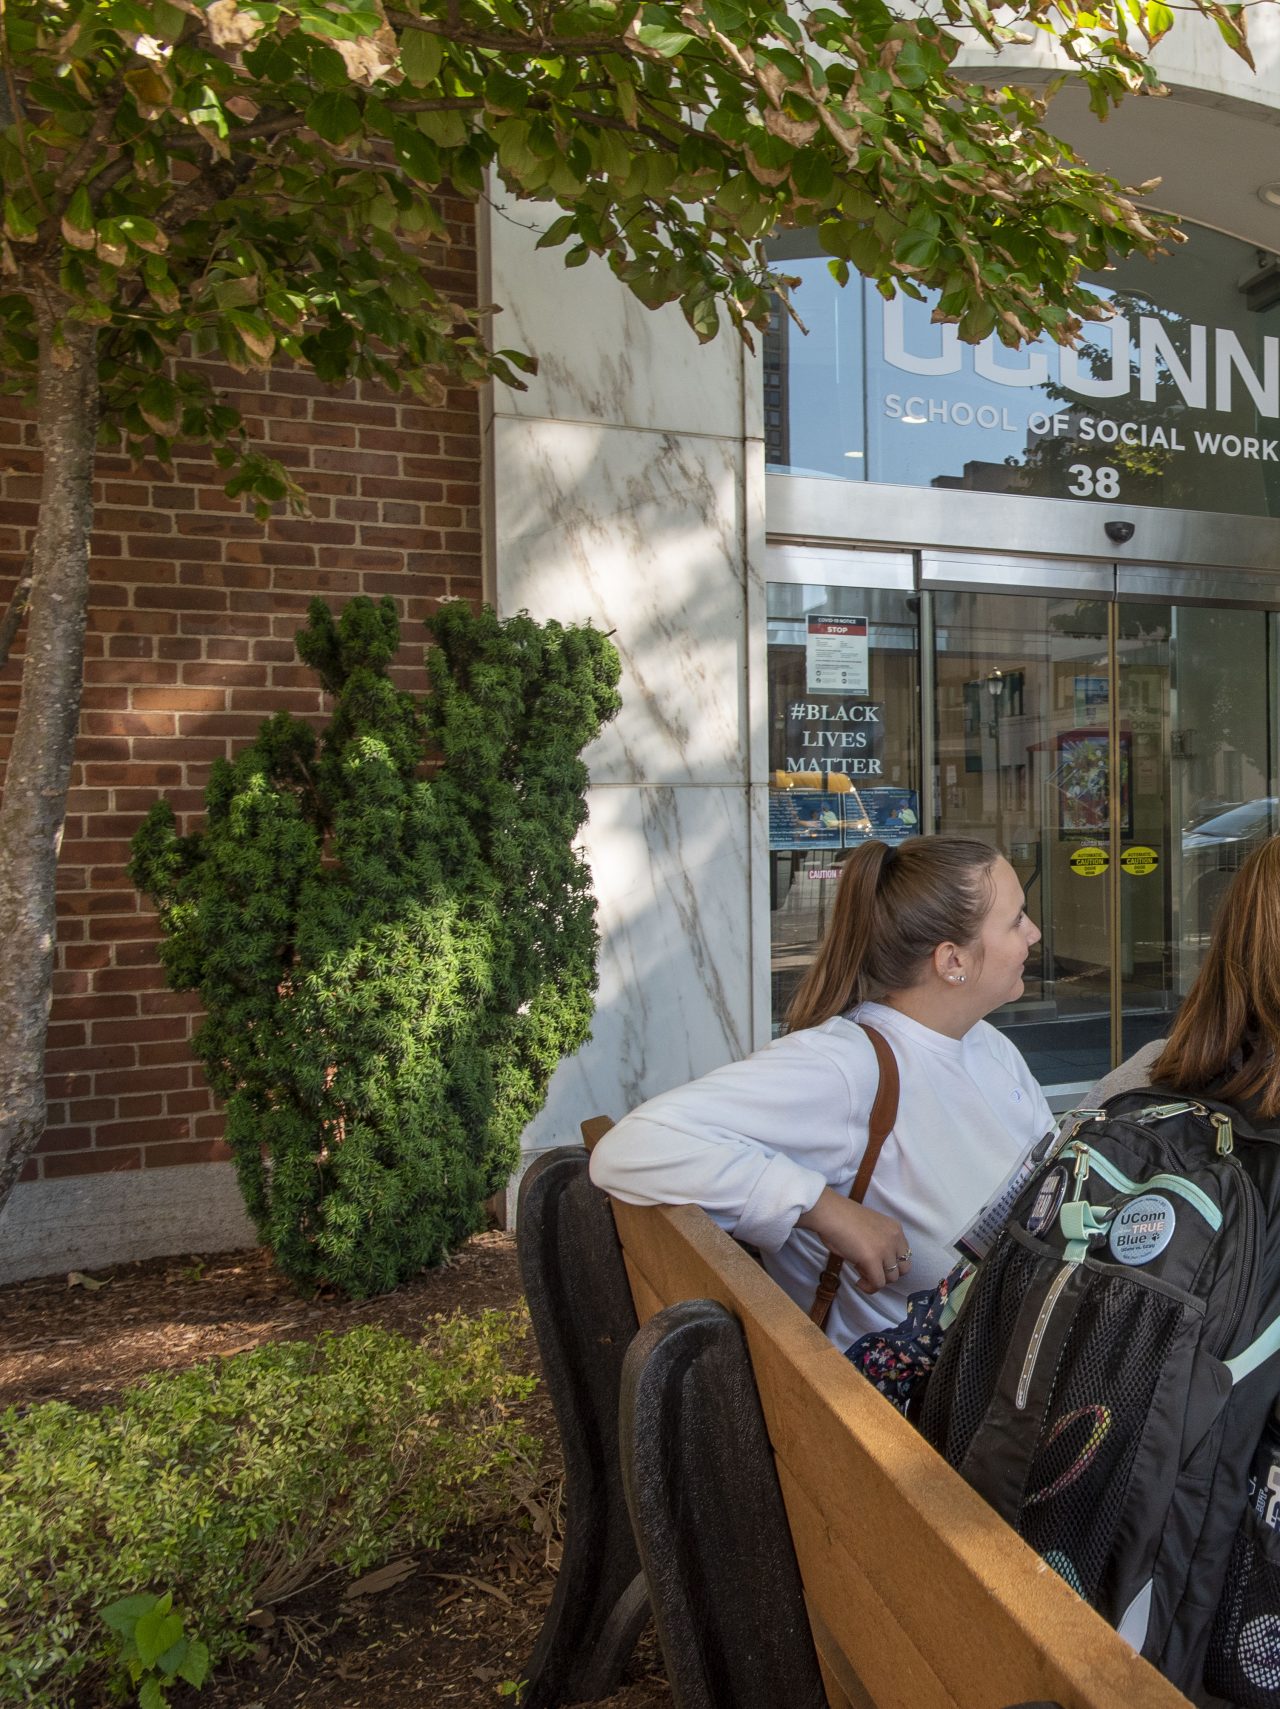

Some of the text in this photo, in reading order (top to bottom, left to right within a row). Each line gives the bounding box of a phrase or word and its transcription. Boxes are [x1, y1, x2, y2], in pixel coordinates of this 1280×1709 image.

[884, 393, 1280, 462] SCHOOL OF SOCIAL WORK
[1068, 464, 1120, 499] 38
[791, 703, 880, 722] #BLACK
[802, 731, 867, 748] LIVES
[786, 757, 883, 774] MATTER
[1126, 857, 1153, 865] CAUTION
[809, 869, 837, 879] CAUTION
[1120, 1211, 1166, 1225] UConn
[1132, 1221, 1165, 1234] TRUE
[1116, 1234, 1147, 1247] Blue
